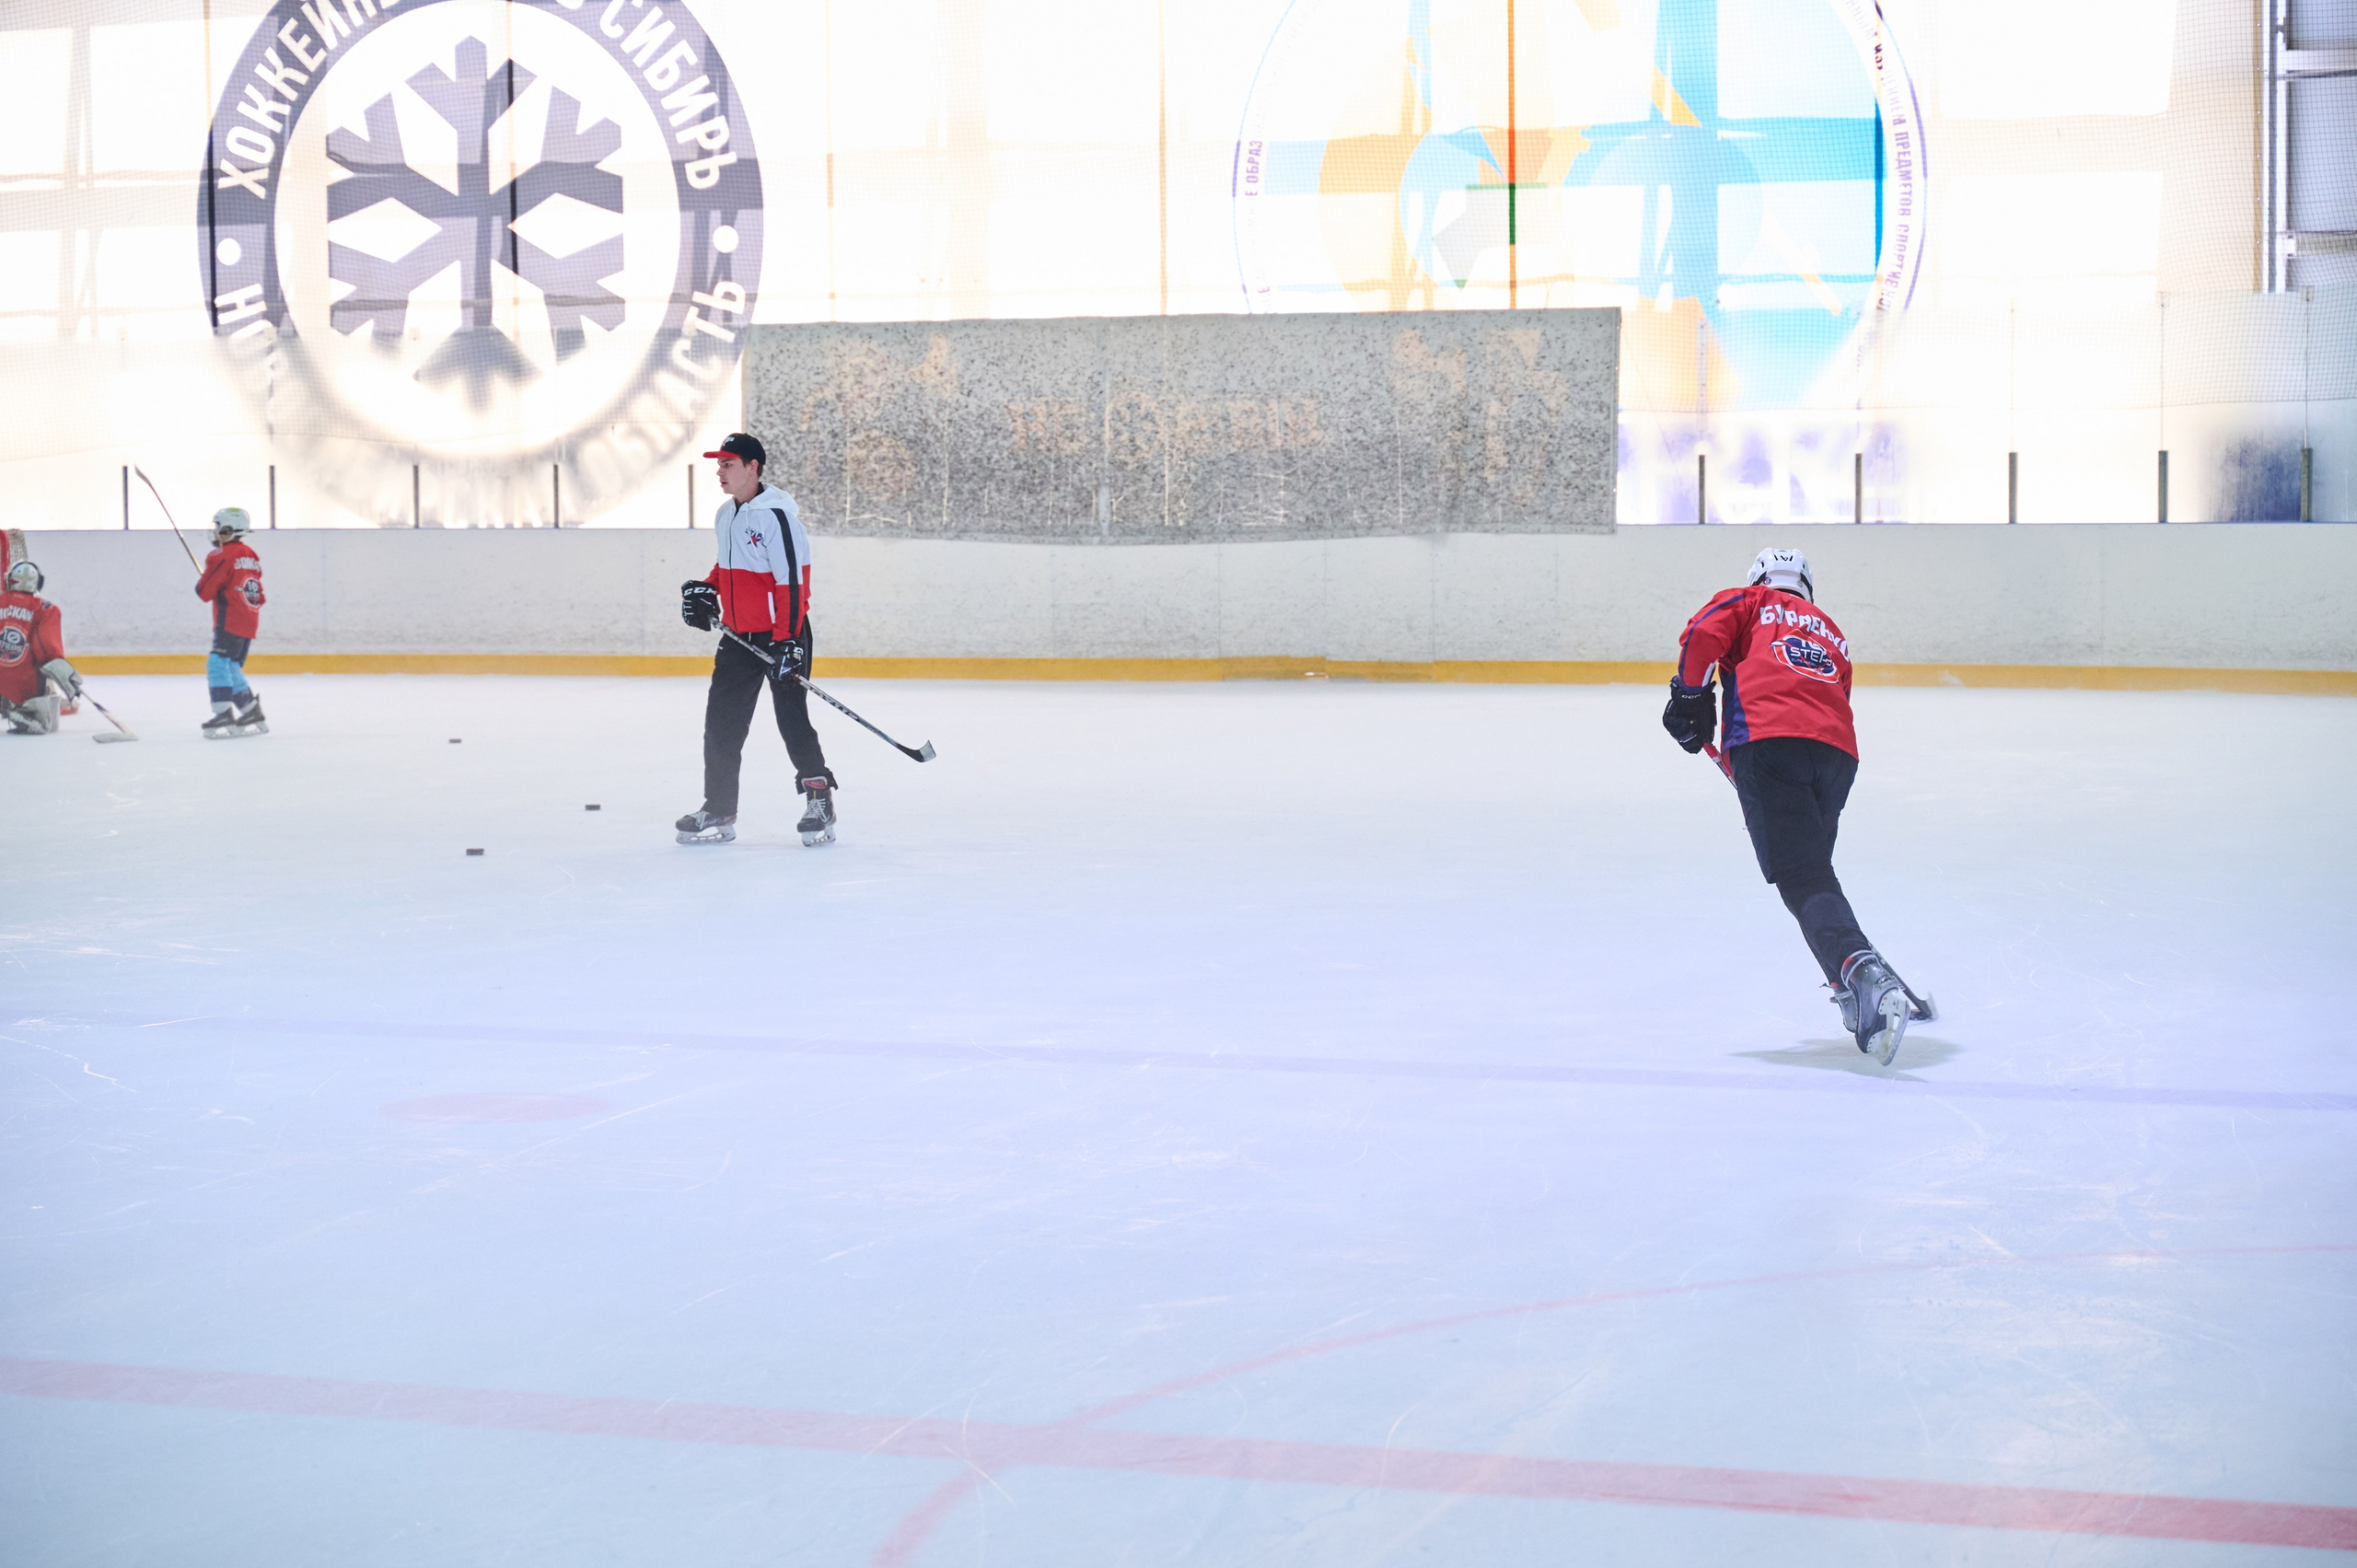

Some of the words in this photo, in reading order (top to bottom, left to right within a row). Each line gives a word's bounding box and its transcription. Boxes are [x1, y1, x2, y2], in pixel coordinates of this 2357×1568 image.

[217, 0, 399, 200] ХОККЕЙ
[599, 0, 737, 190] СИБИРЬ
[1895, 131, 1912, 216] ПРЕДМЕТОВ
[684, 587, 717, 597] CCM
